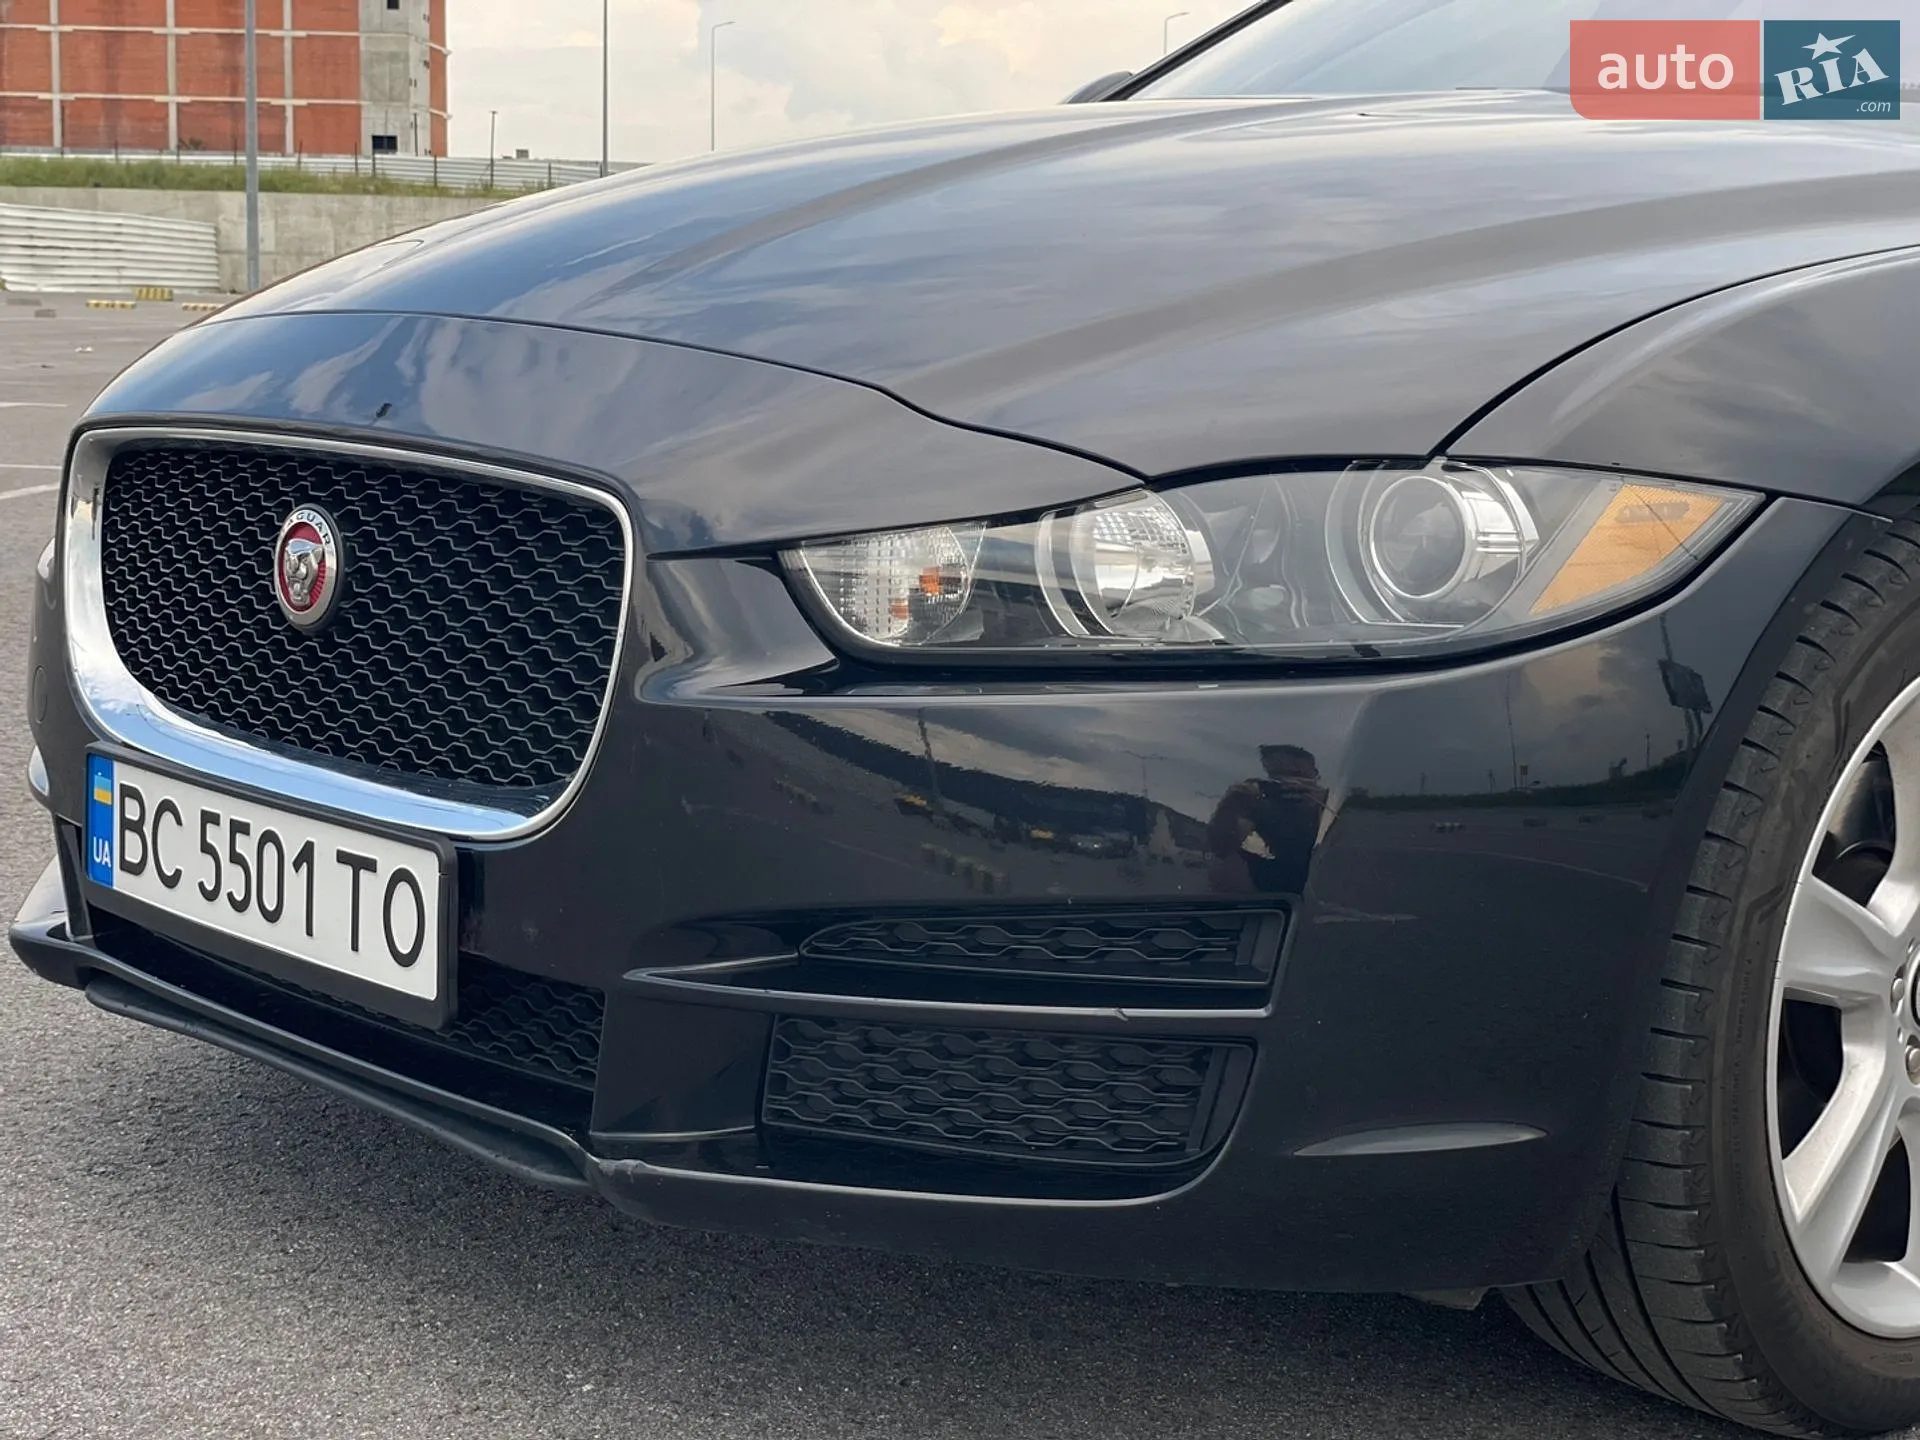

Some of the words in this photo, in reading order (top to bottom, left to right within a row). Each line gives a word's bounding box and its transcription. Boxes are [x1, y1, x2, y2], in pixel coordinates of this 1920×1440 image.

[281, 511, 332, 546] AGUAR
[93, 836, 112, 868] UA
[118, 781, 184, 890] BC
[197, 808, 315, 938] 5501
[335, 848, 426, 969] TO
